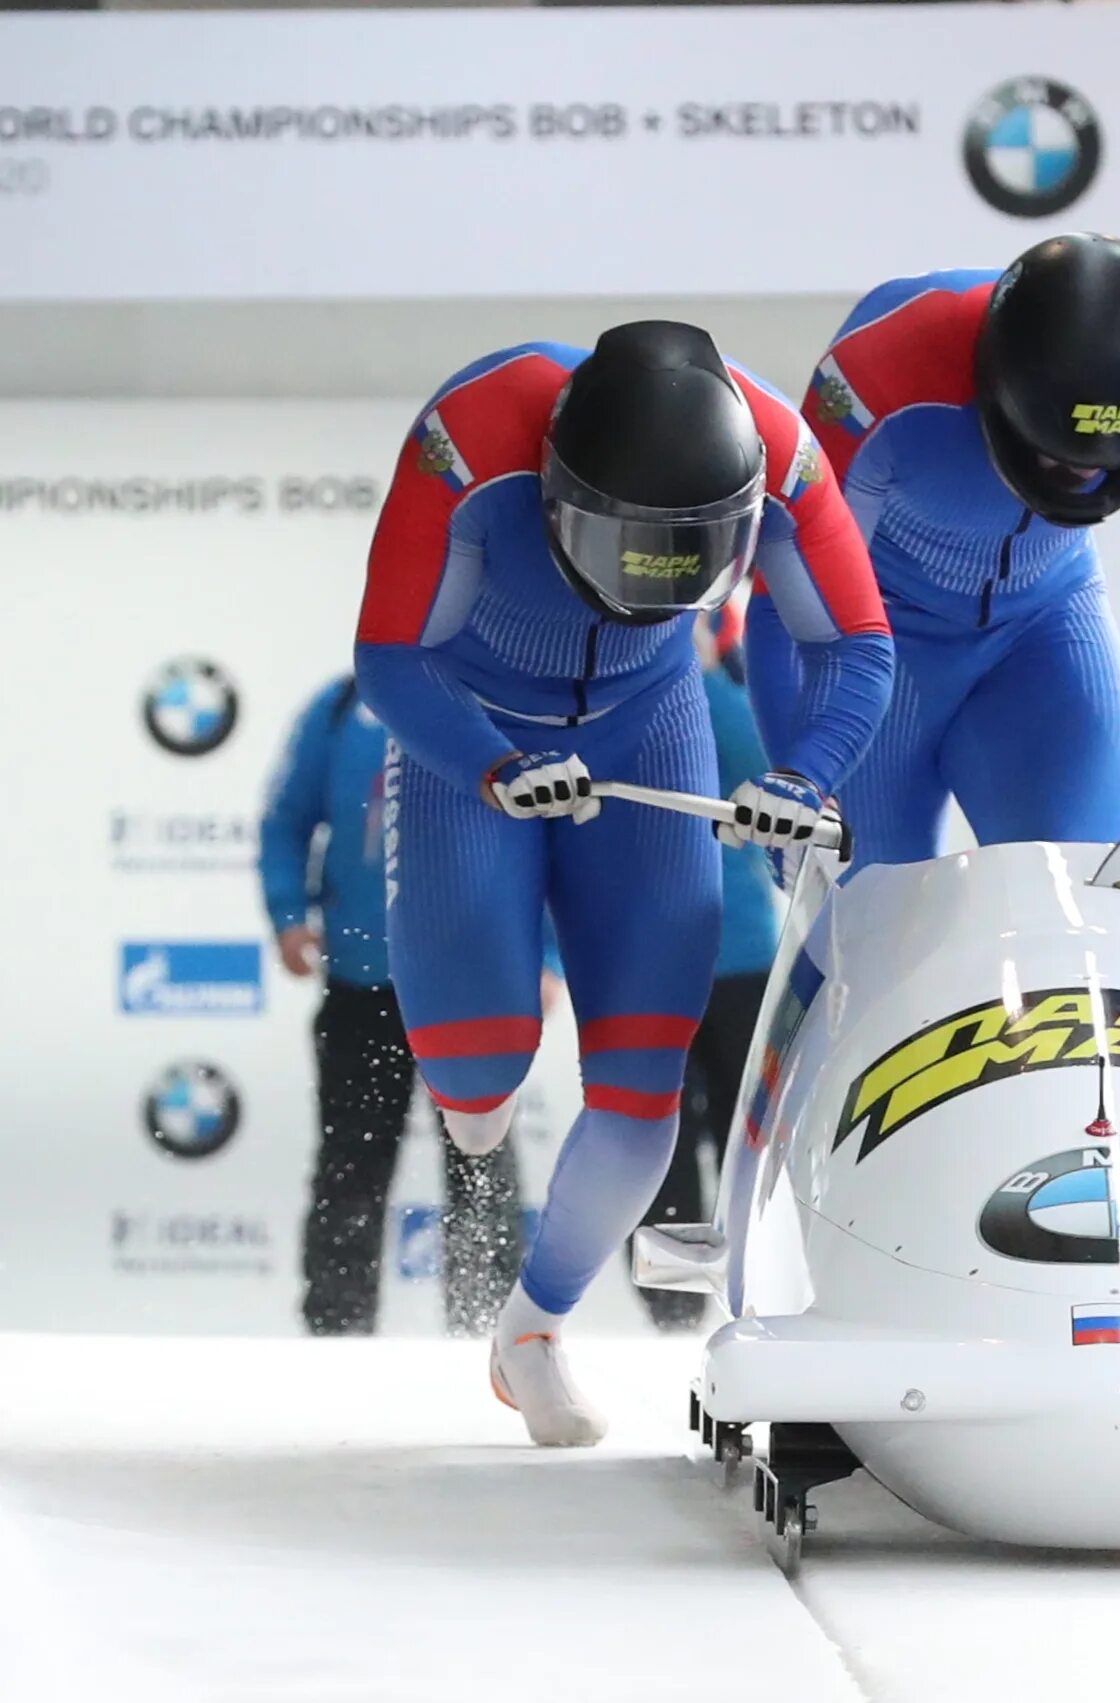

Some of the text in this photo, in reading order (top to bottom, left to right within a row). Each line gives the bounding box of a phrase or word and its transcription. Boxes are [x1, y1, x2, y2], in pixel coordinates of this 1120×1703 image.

[127, 103, 517, 142] CHAMPIONSHIPS
[529, 102, 628, 141] BOB
[677, 100, 920, 138] SKELETON
[0, 476, 379, 514] PIONSHIPS BOB
